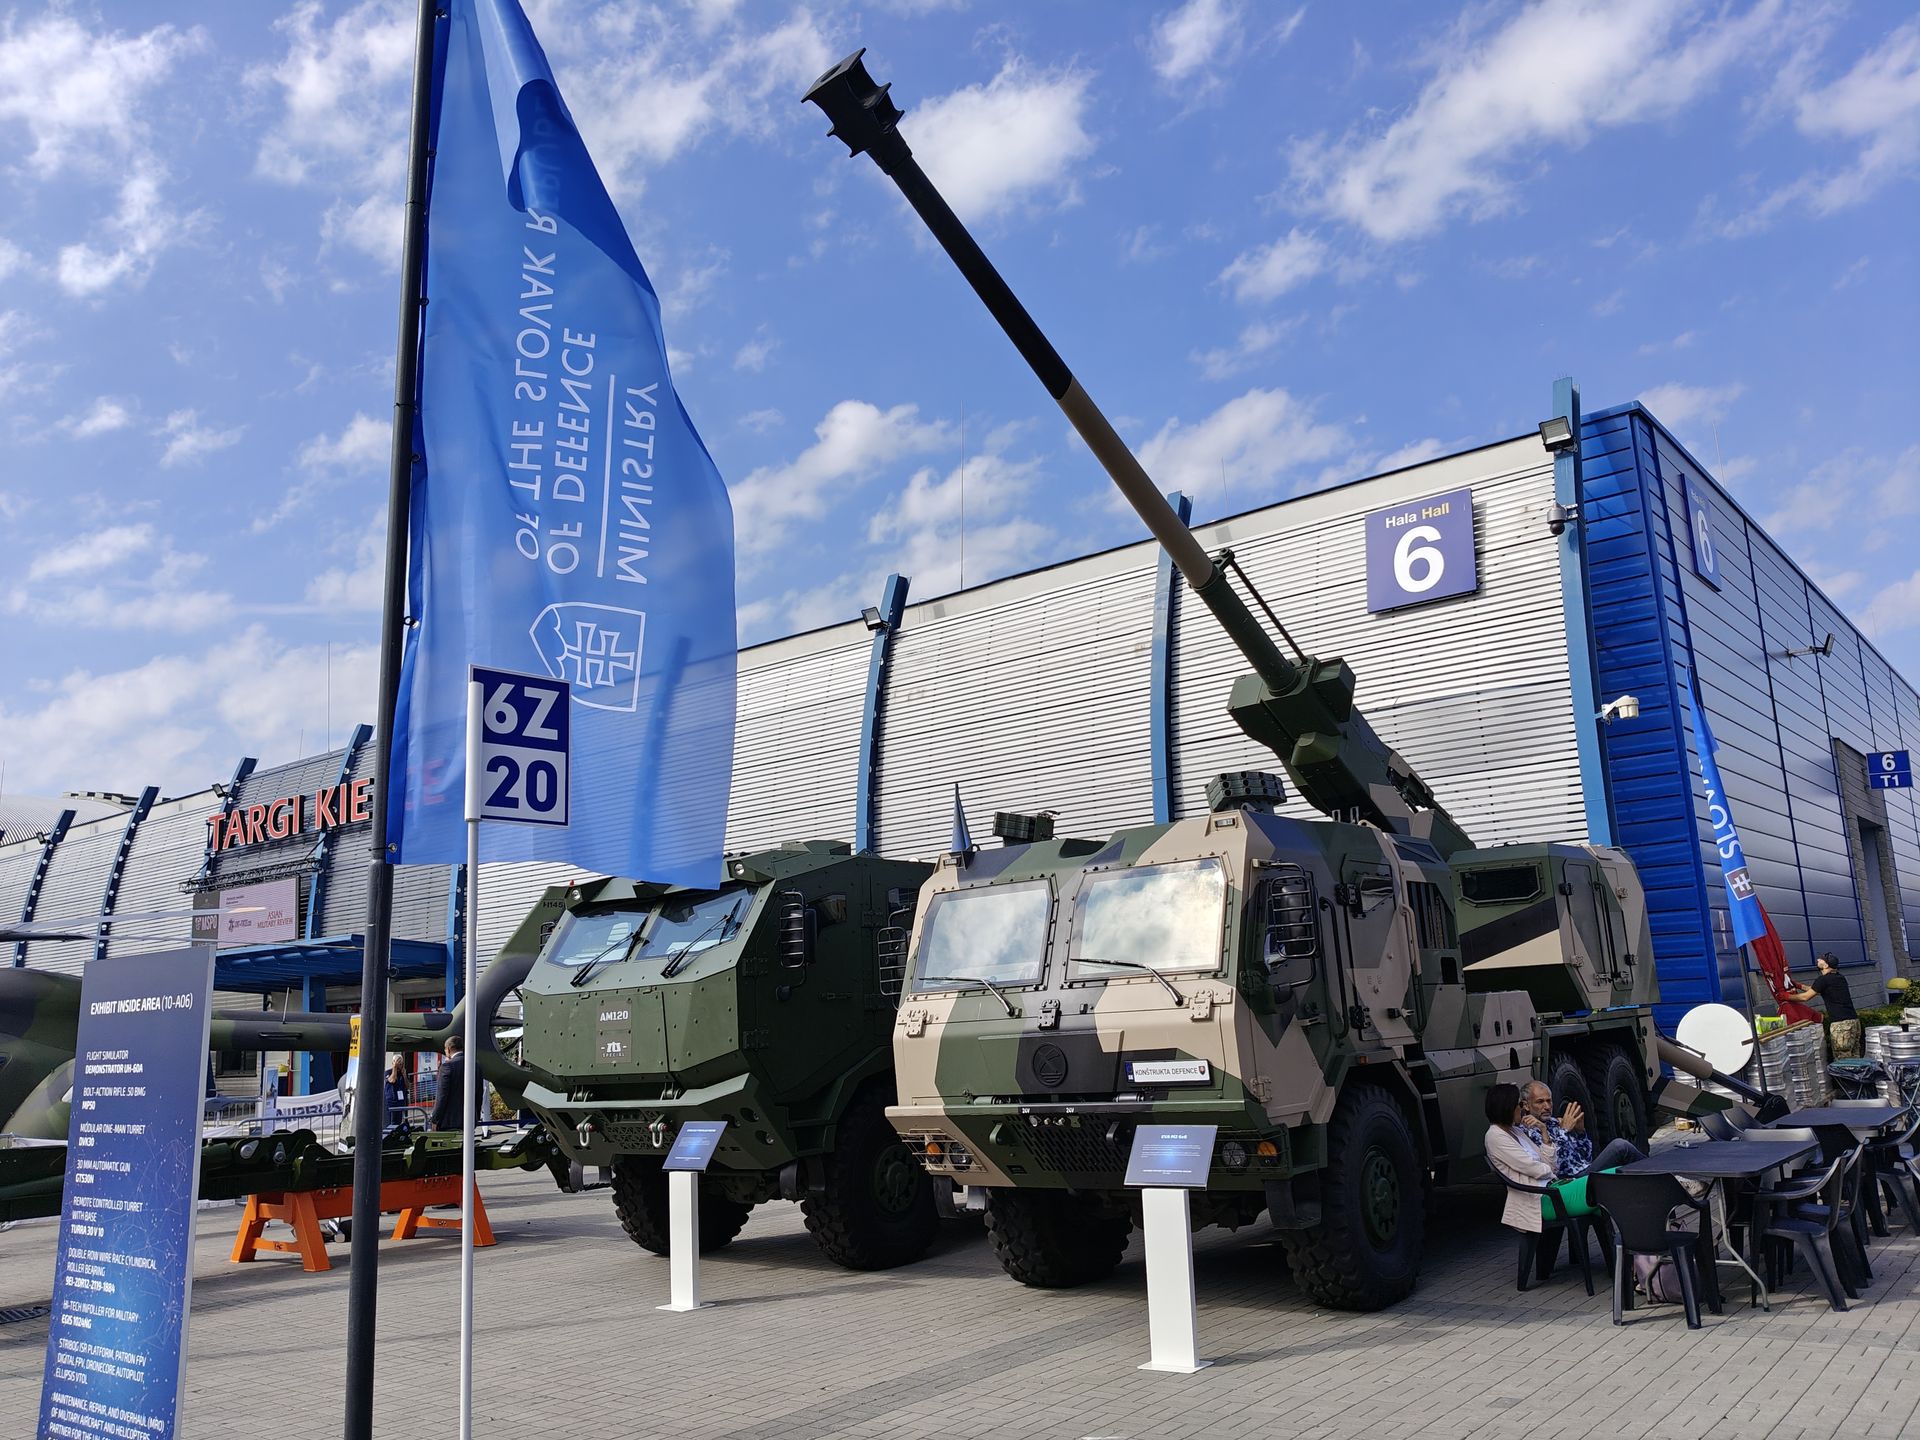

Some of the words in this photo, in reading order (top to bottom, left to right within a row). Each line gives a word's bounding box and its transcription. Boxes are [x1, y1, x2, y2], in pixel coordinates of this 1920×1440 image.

[1385, 513, 1417, 528] Hala
[1421, 502, 1450, 520] Hall
[1697, 510, 1713, 574] 6
[1394, 525, 1444, 593] 6
[484, 682, 560, 741] 6Z
[1881, 753, 1896, 771] 6
[484, 755, 558, 812] 20
[1880, 774, 1899, 787] T1
[208, 794, 301, 852] TARGI
[90, 1001, 117, 1015] EXHIBIT
[117, 999, 140, 1013] INSIDE
[141, 997, 160, 1011] AREA
[161, 992, 193, 1012] (10-A06)
[600, 1010, 628, 1022] AM120
[86, 1050, 102, 1060] FLIGHT
[102, 1049, 128, 1060] SIMULATOR
[85, 1064, 124, 1074] DEMONSTRATOR
[1135, 1067, 1170, 1076] KONŠTRUKTA
[1171, 1067, 1198, 1075] DEFENCE
[127, 1124, 146, 1134] TURRET
[93, 1160, 119, 1171] AUTOMATIC
[120, 1162, 130, 1172] GUN
[73, 1196, 92, 1207] REMOTE
[93, 1198, 123, 1210] CONTROLLED
[124, 1201, 143, 1212] TURRET
[85, 1211, 97, 1222] BASE
[67, 1261, 84, 1273] ROLLER
[115, 1309, 139, 1323] MILITARY
